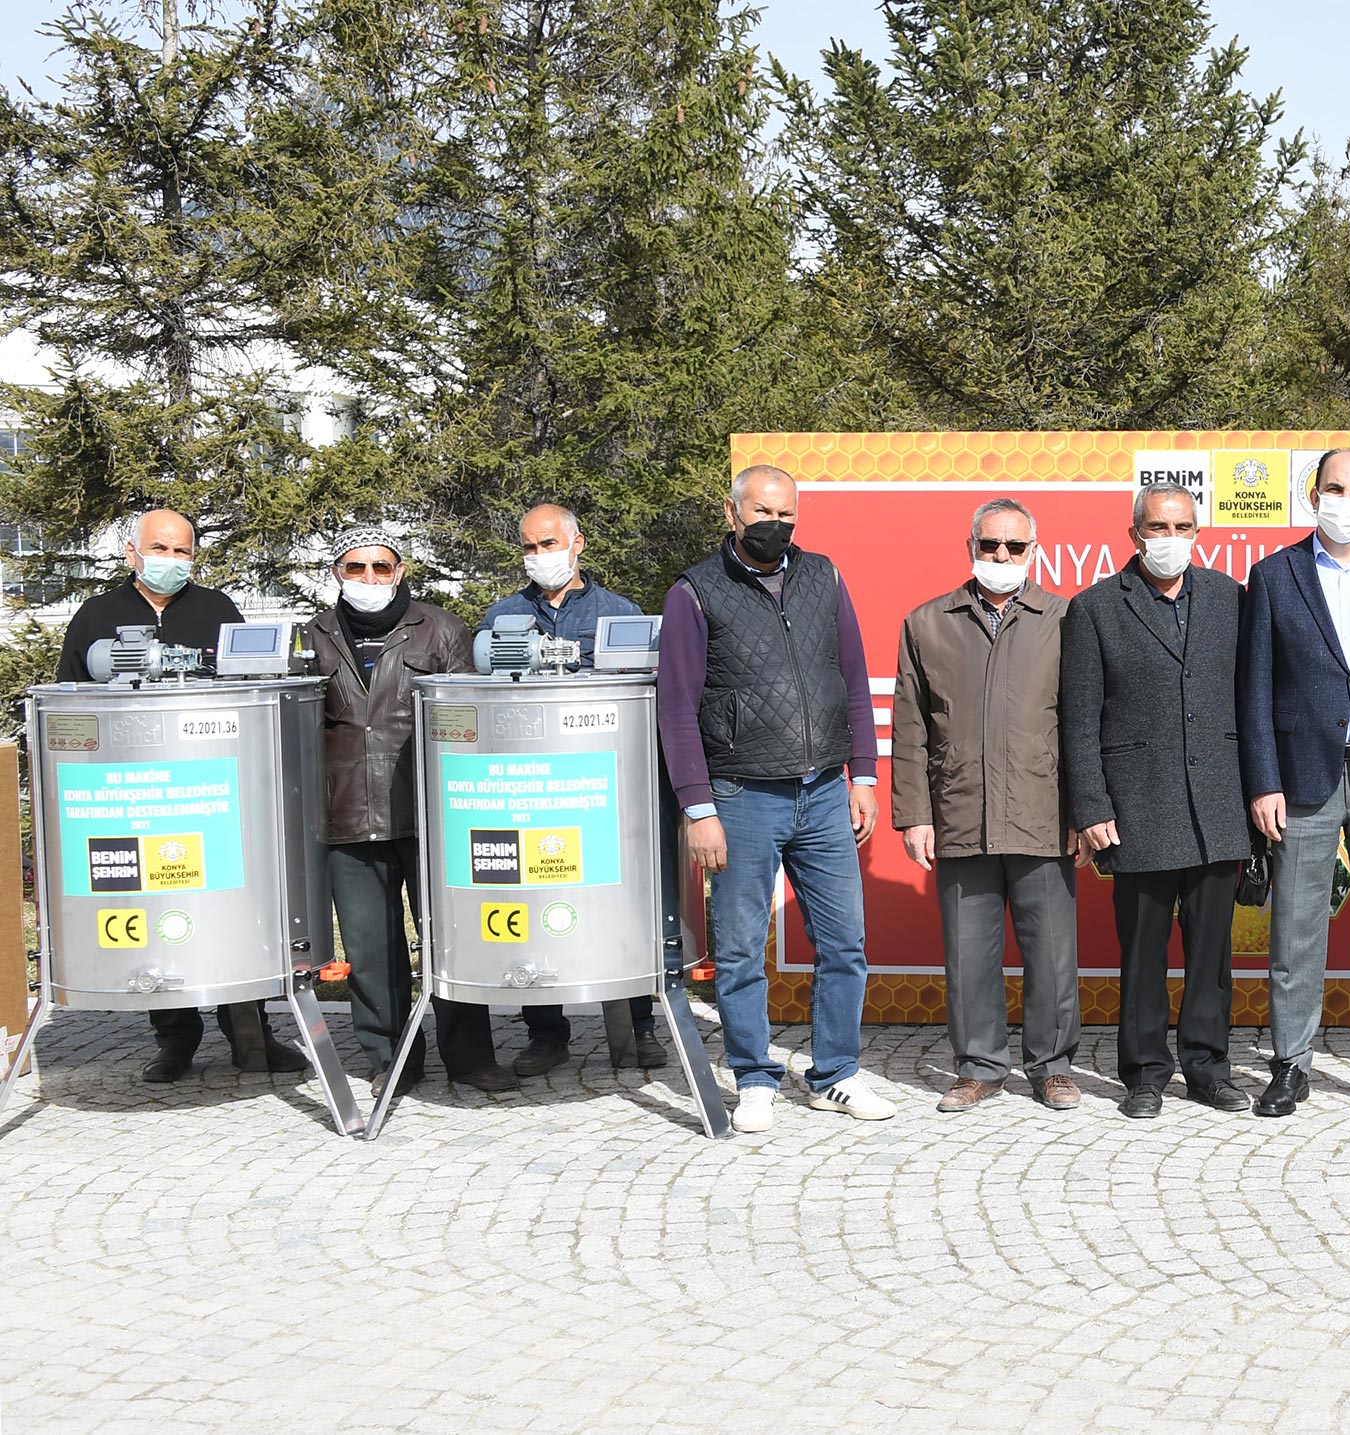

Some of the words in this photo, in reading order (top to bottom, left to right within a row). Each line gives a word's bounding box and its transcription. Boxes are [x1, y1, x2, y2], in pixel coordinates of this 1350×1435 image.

[1235, 491, 1267, 499] KONYA
[1219, 500, 1283, 511] BÜYÜKŞEHİR
[1035, 544, 1117, 586] NYA
[563, 712, 616, 728] 42.2021.42
[182, 721, 237, 735] 42.2021.36
[489, 764, 504, 776] BU
[507, 761, 551, 776] MAKİNE
[106, 771, 122, 784] BU
[447, 780, 475, 793] KONYA
[63, 789, 93, 802] KONYA
[449, 797, 505, 810] TARAFINDAN
[105, 915, 140, 942] CE
[487, 909, 521, 937] CE
